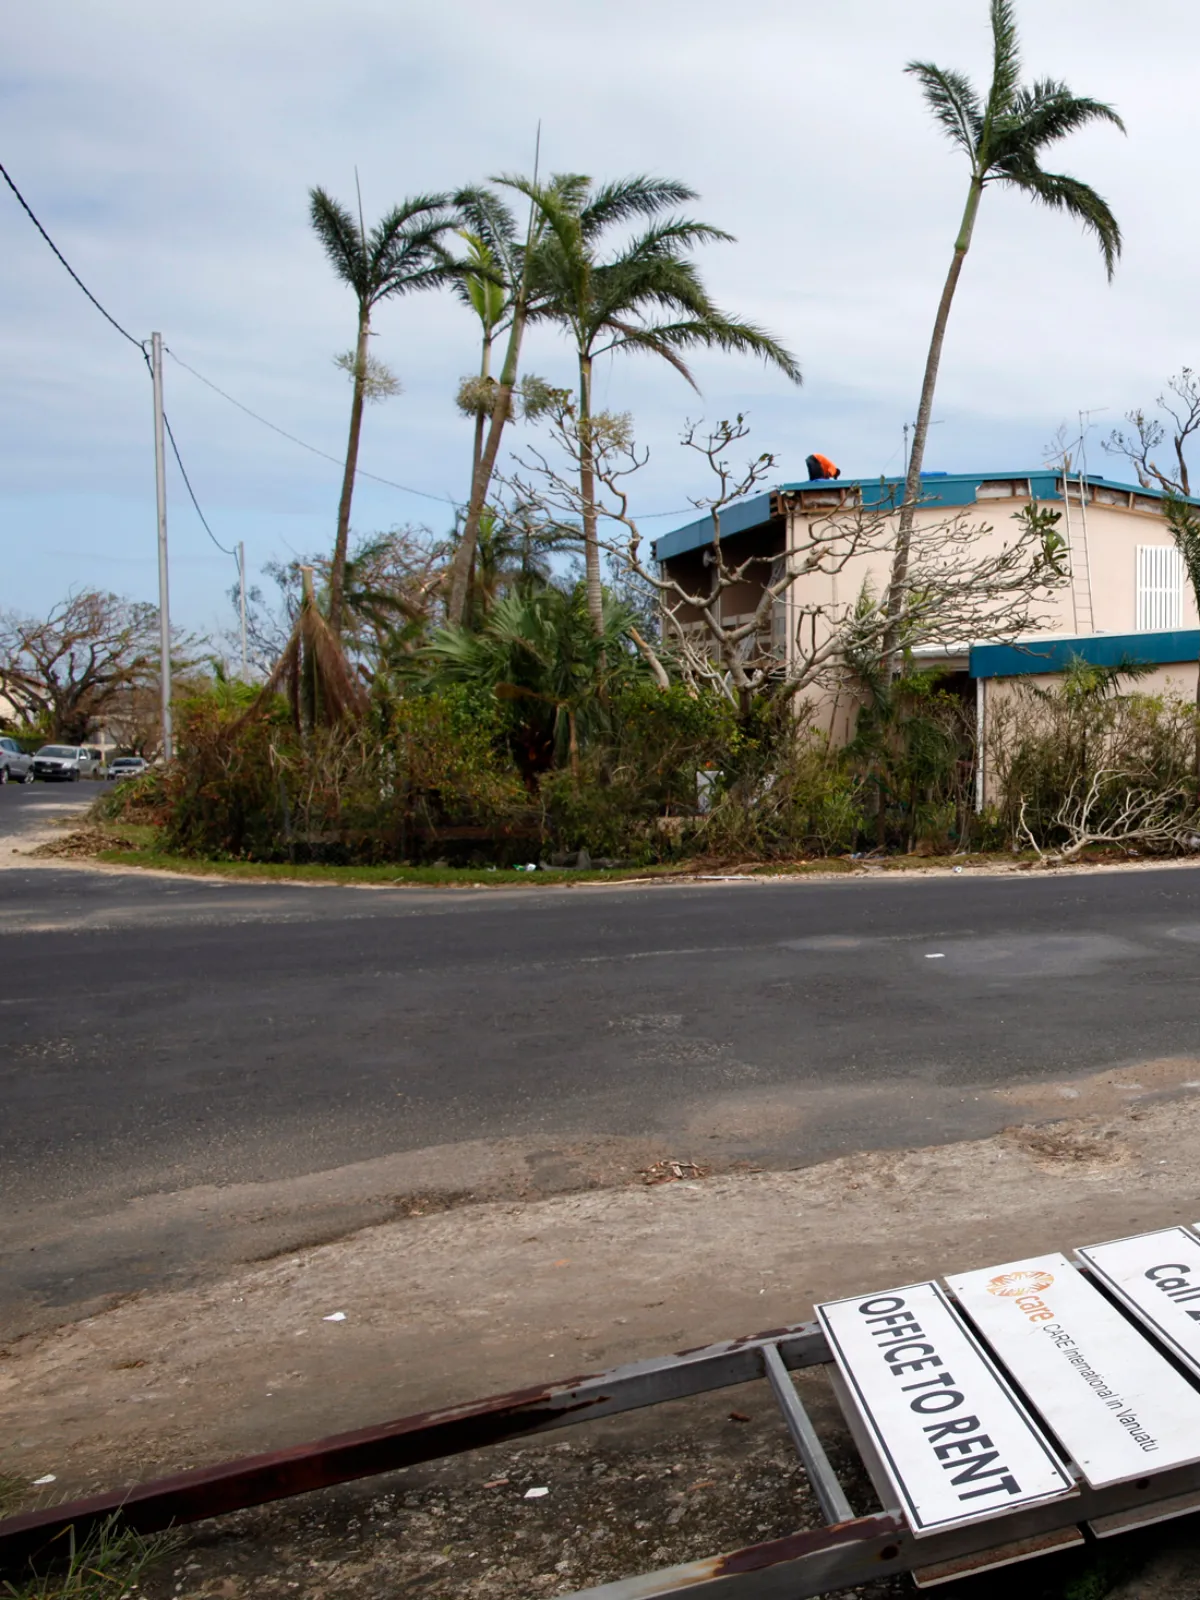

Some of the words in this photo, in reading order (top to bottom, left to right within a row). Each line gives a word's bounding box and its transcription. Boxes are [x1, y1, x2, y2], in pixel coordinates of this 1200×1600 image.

[858, 1296, 948, 1377] OFFICE
[1015, 1295, 1055, 1323] care
[901, 1370, 966, 1415] TO
[1043, 1323, 1076, 1349] CARE
[1062, 1347, 1120, 1400] International
[1105, 1398, 1125, 1411] in
[1115, 1408, 1160, 1453] Vanuatu
[922, 1415, 1023, 1502] RENT
